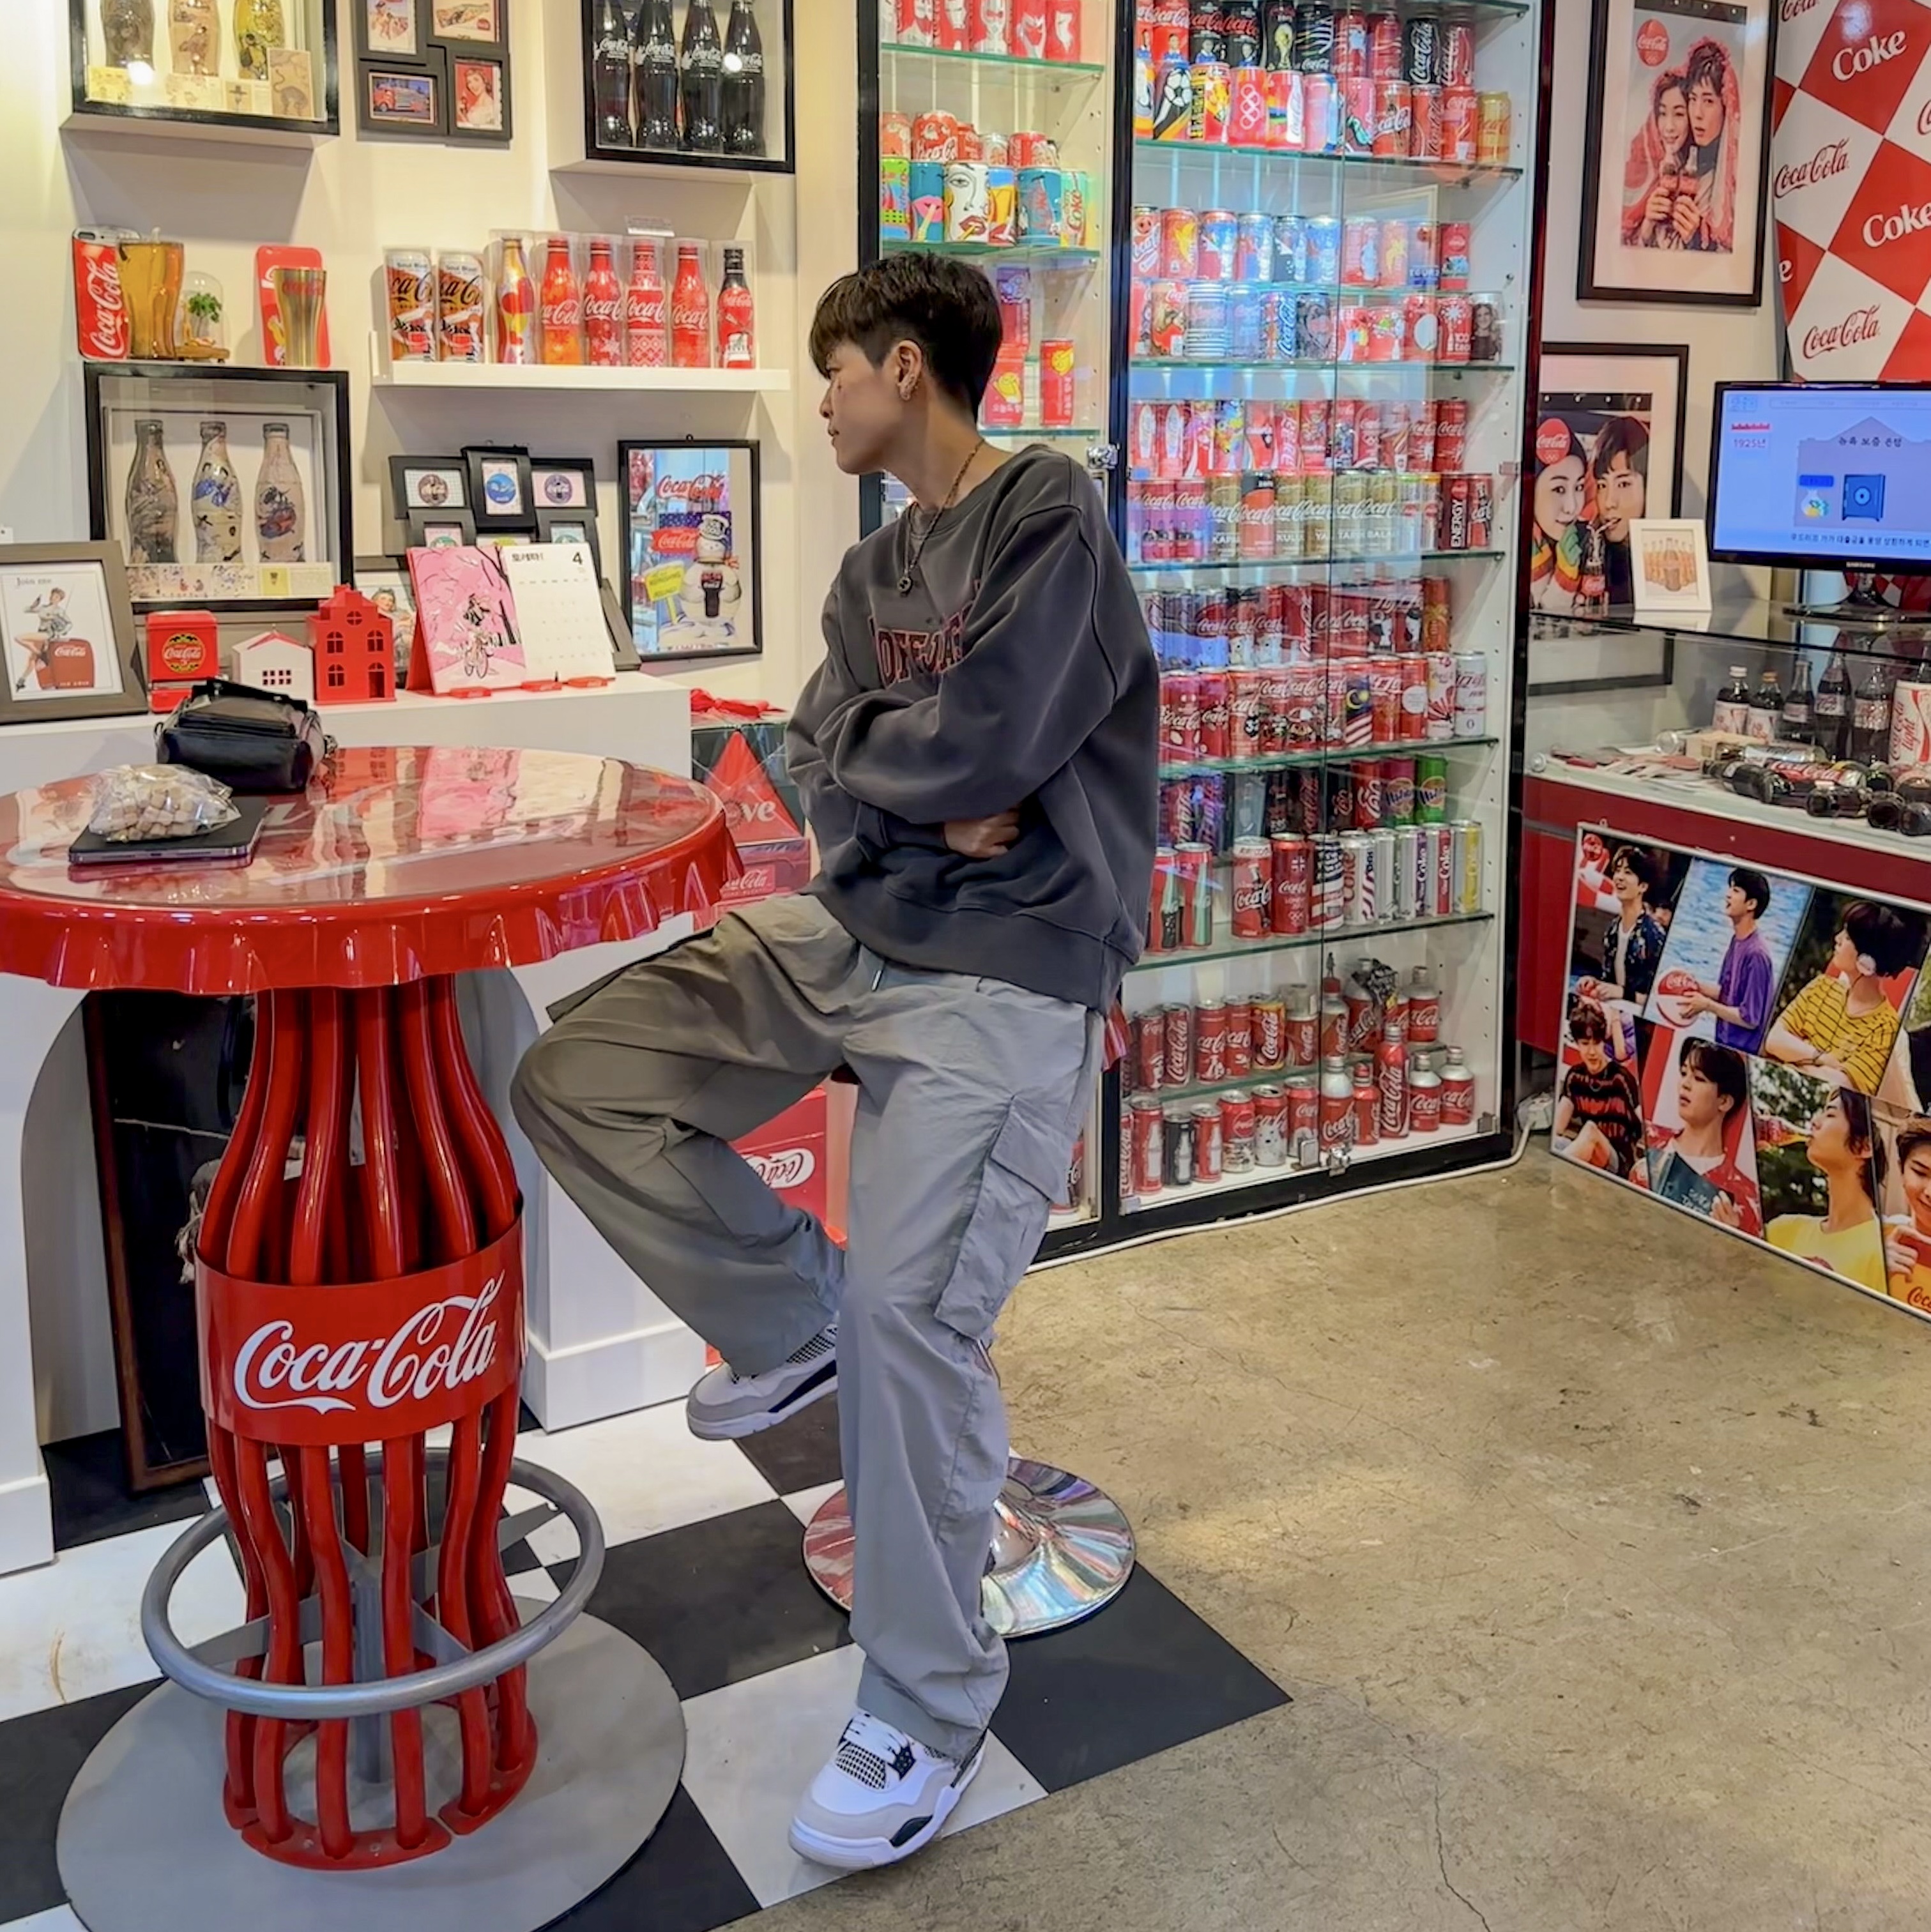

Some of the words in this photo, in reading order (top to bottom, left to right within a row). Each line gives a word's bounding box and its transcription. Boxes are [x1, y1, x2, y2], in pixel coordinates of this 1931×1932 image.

[1832, 31, 1907, 81] Coke
[1775, 137, 1850, 199] Coca-Cola
[1862, 202, 1931, 248] Coke
[80, 255, 125, 356] Coca-Cola
[1803, 304, 1881, 359] Coca-Cola
[1451, 499, 1463, 547] ENERGY
[572, 552, 583, 565] 4
[164, 645, 201, 660] Coca-Cola
[1378, 1063, 1403, 1134] Coca-Cola
[234, 1269, 505, 1415] Coca-Cola
